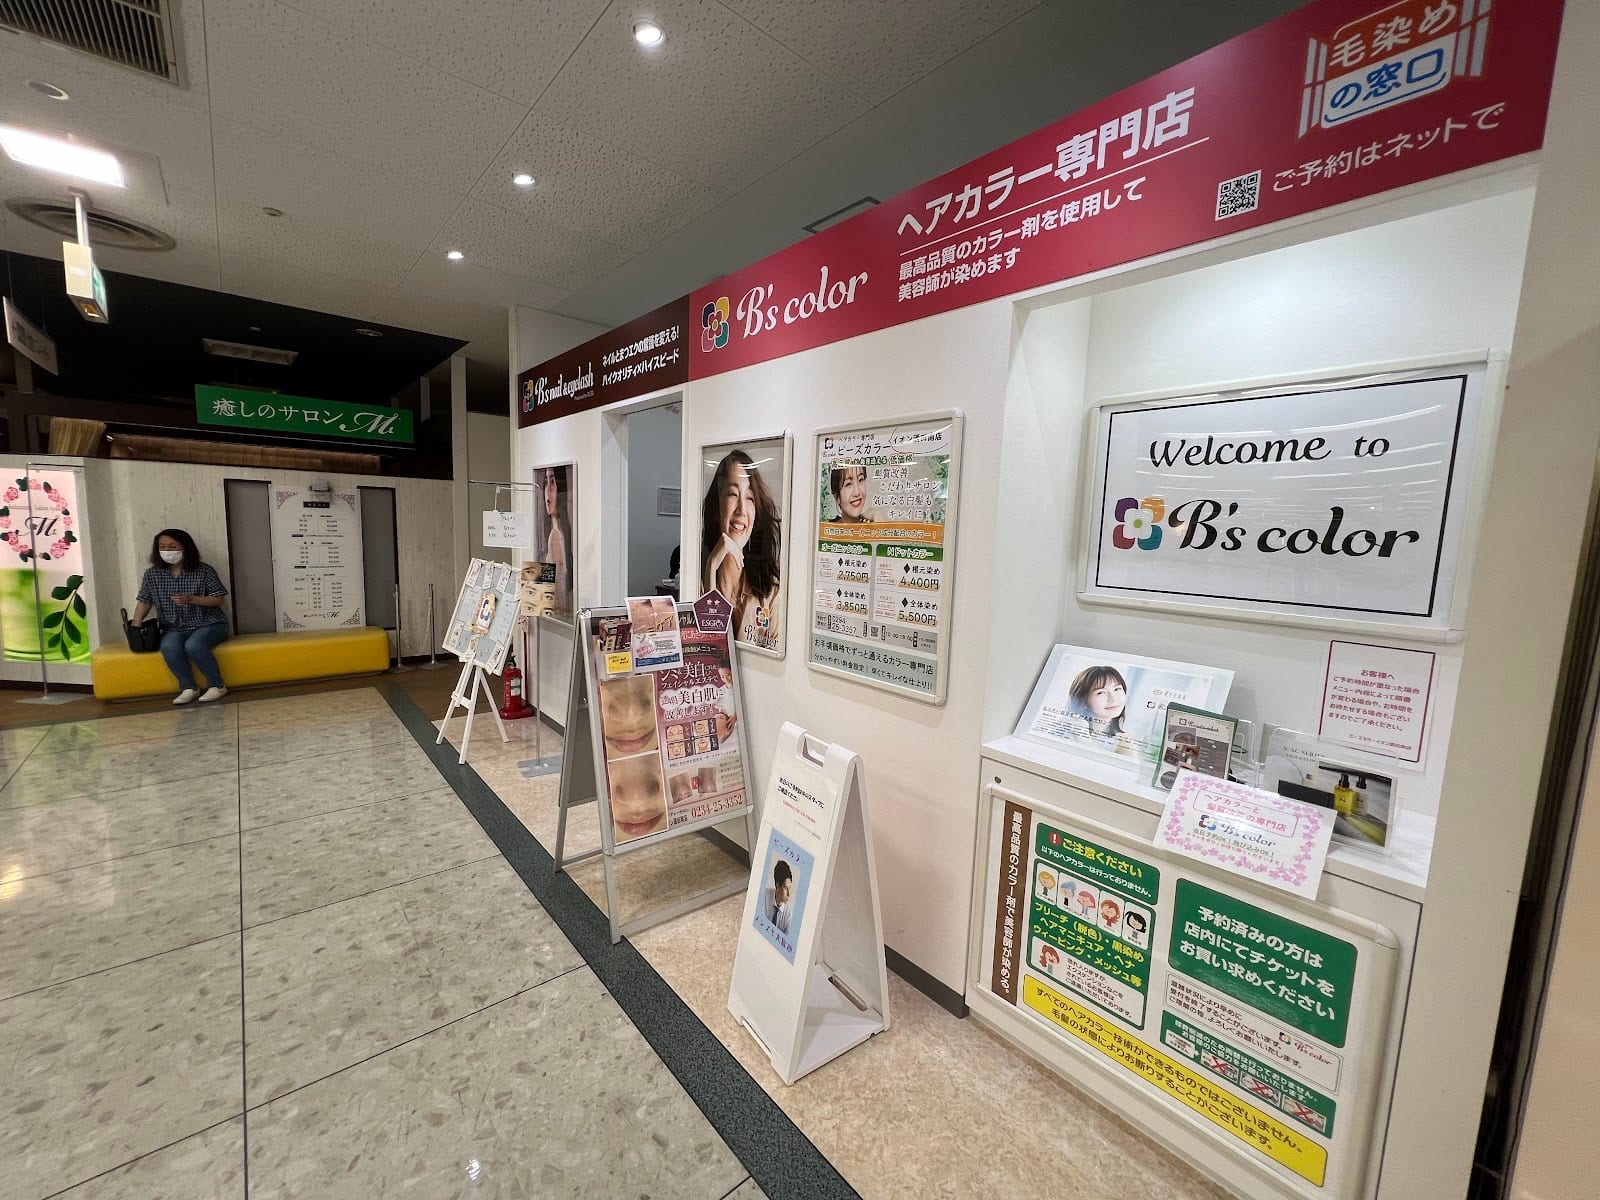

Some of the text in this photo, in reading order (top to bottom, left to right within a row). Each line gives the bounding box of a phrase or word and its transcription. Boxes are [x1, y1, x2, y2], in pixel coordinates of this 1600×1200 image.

[1329, 0, 1457, 67] 毛染め
[1330, 47, 1444, 109] の窓口
[896, 86, 1197, 236] ヘアカラー専門店
[1271, 101, 1506, 192] ご予約はネットで
[898, 177, 1146, 280] 最高品質のカラー剤を使用して
[736, 265, 869, 339] B's color
[898, 248, 1021, 303] 美容師が染めます
[550, 373, 563, 401] nail
[567, 361, 595, 398] eyelash
[211, 397, 344, 425] 癒しのサロン
[838, 442, 891, 456] ビーズカラー
[1150, 435, 1391, 468] Welcome to
[880, 481, 940, 492] こだわりサロン
[1168, 499, 1420, 558] B's color
[911, 565, 941, 576] 根元染め
[910, 599, 938, 611] 全体染め
[1332, 675, 1420, 695] ご予約時間が重なった場合
[1360, 669, 1396, 680] お客様へ
[1204, 793, 1261, 815] ヘアカラーと
[1040, 844, 1152, 898] 以下のヘアカラーは行っておりません。
[1062, 838, 1143, 879] ご注意ください
[1183, 920, 1336, 998] 店内にてチケットを
[1197, 905, 1324, 969] 予約済みの方は
[1179, 939, 1335, 1021] お買い求めください
